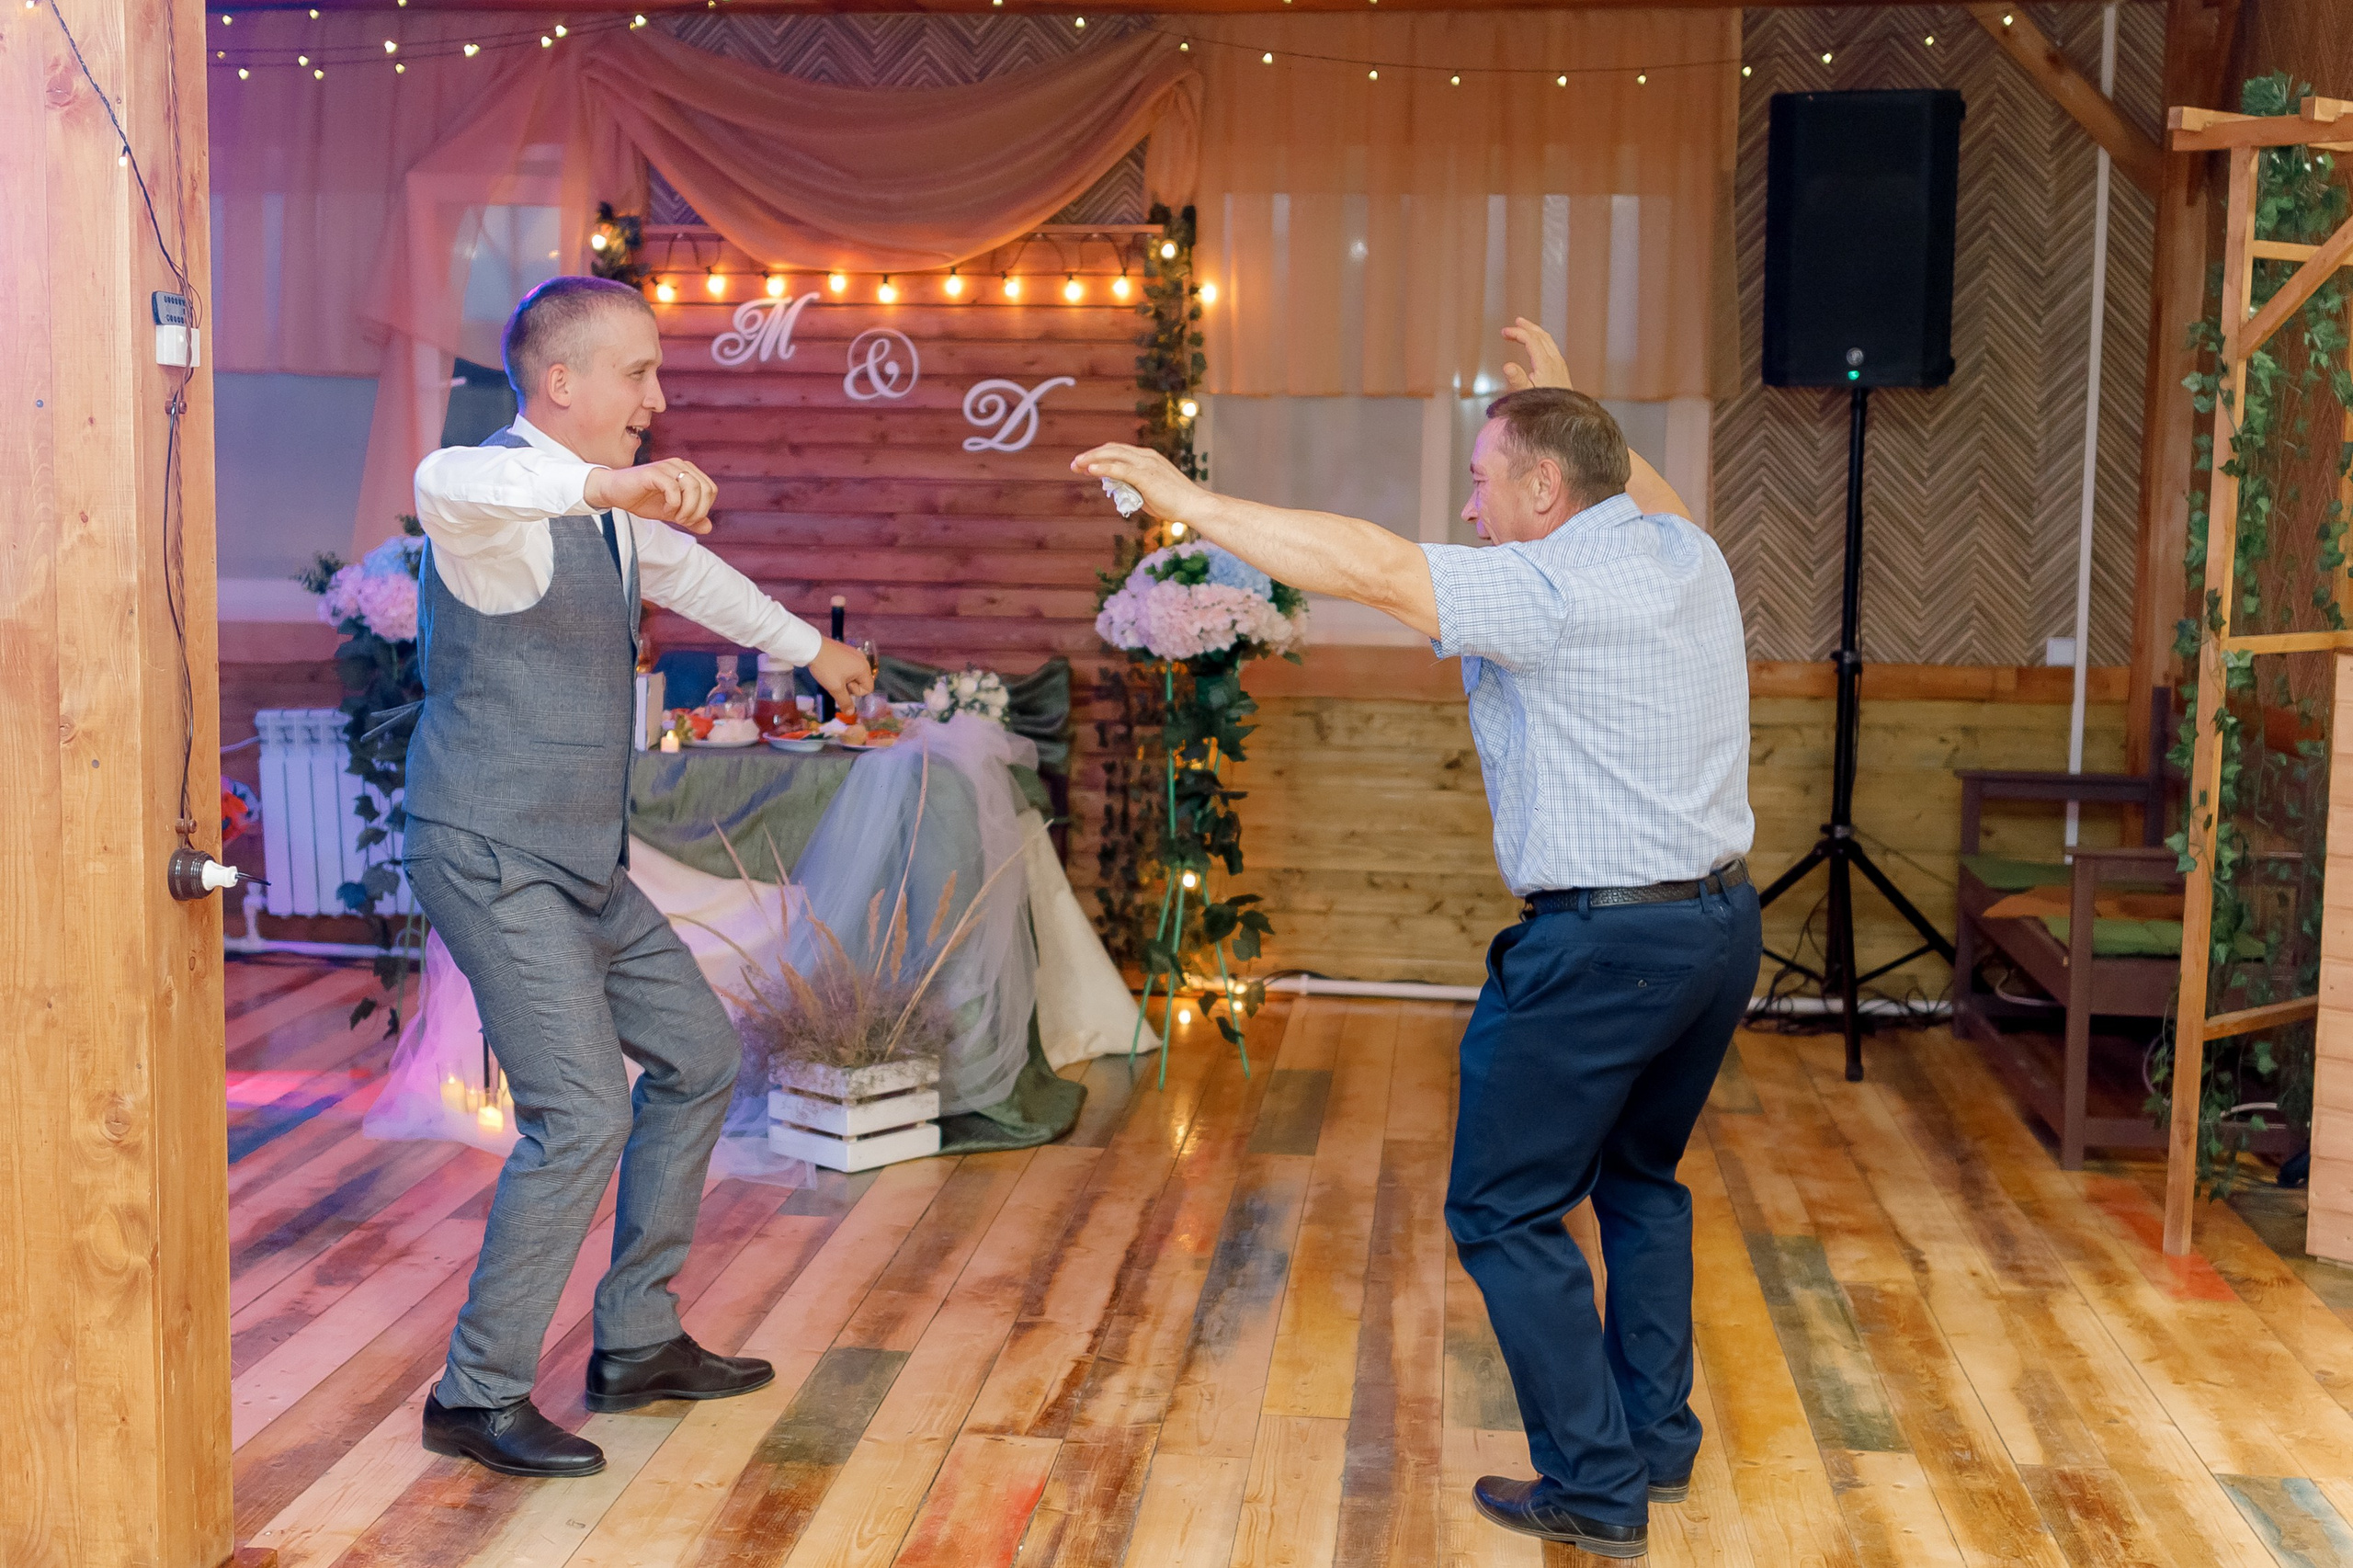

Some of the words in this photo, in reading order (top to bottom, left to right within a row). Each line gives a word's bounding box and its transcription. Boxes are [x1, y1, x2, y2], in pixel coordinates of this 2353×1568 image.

[710, 291, 820, 366] M
[843, 327, 919, 401] &
[962, 376, 1076, 452] D
